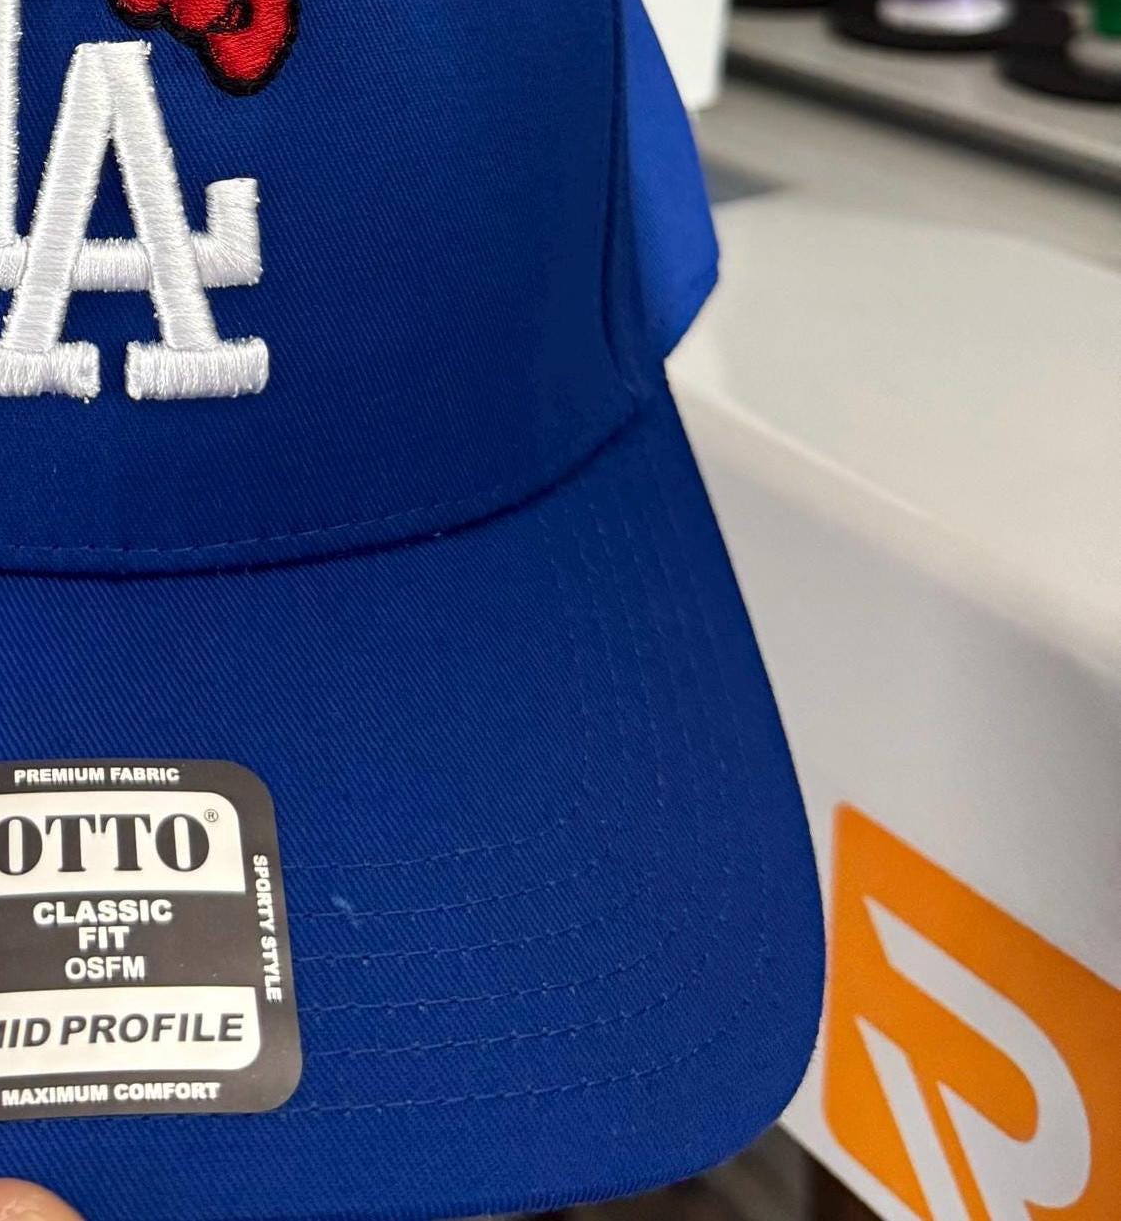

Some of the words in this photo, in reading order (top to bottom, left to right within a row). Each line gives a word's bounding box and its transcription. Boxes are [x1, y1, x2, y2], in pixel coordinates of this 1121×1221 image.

[14, 768, 104, 783] PREMIUM
[110, 768, 180, 782] FABRIC
[253, 854, 275, 934] SPORTY
[33, 900, 172, 924] CLASSIC
[78, 926, 129, 950] FIT
[65, 956, 145, 981] OSFM
[260, 936, 282, 1003] STYLE
[60, 1013, 244, 1045] PROFILE
[2, 1085, 108, 1106] MAXIMUM
[114, 1082, 220, 1100] COMFORT
